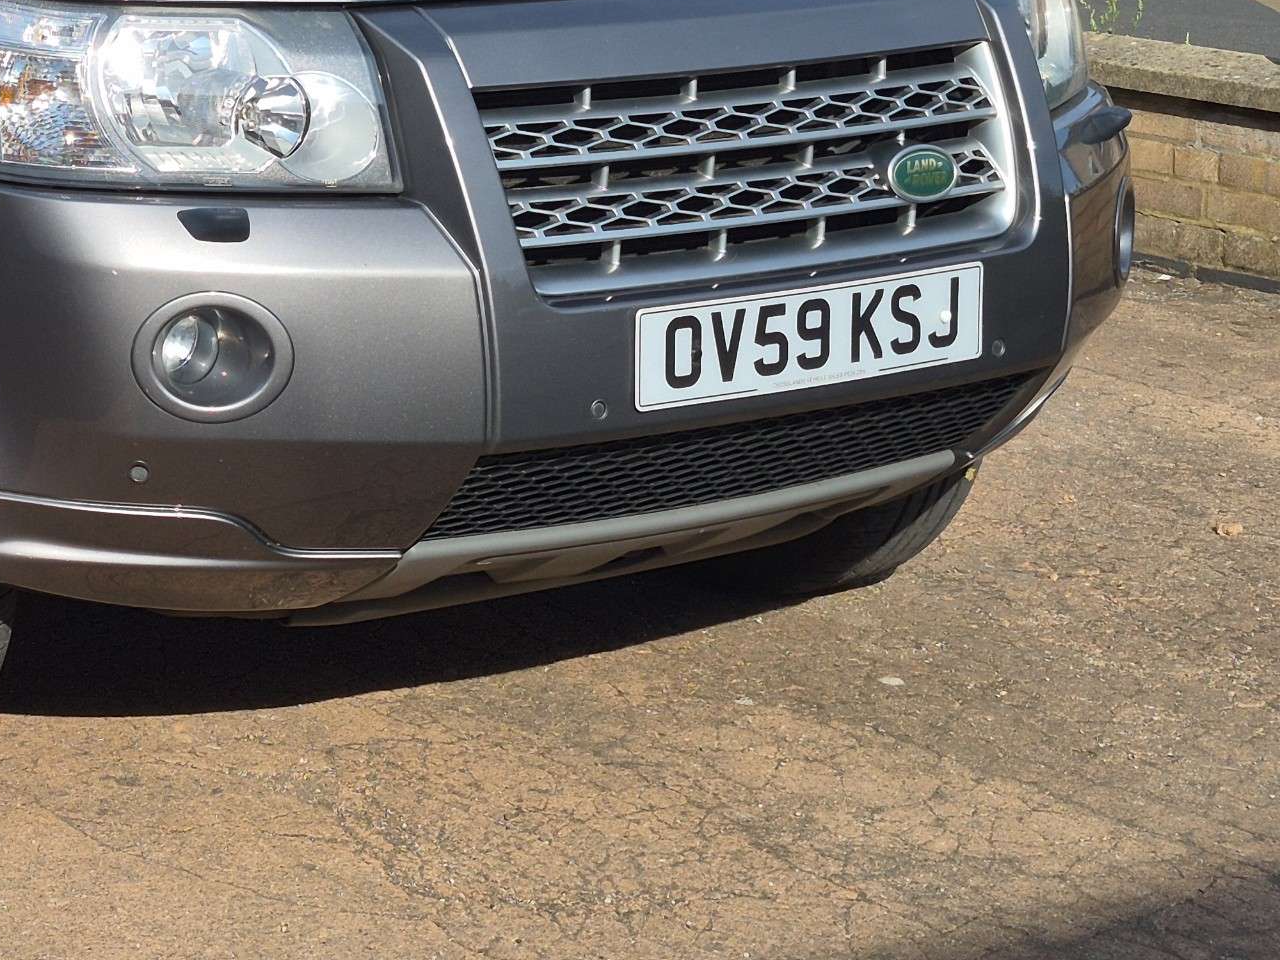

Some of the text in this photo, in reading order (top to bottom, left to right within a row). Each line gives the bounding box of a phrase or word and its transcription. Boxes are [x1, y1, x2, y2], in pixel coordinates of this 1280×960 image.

[906, 158, 937, 174] LAND
[664, 276, 960, 390] OV59 KSJ
